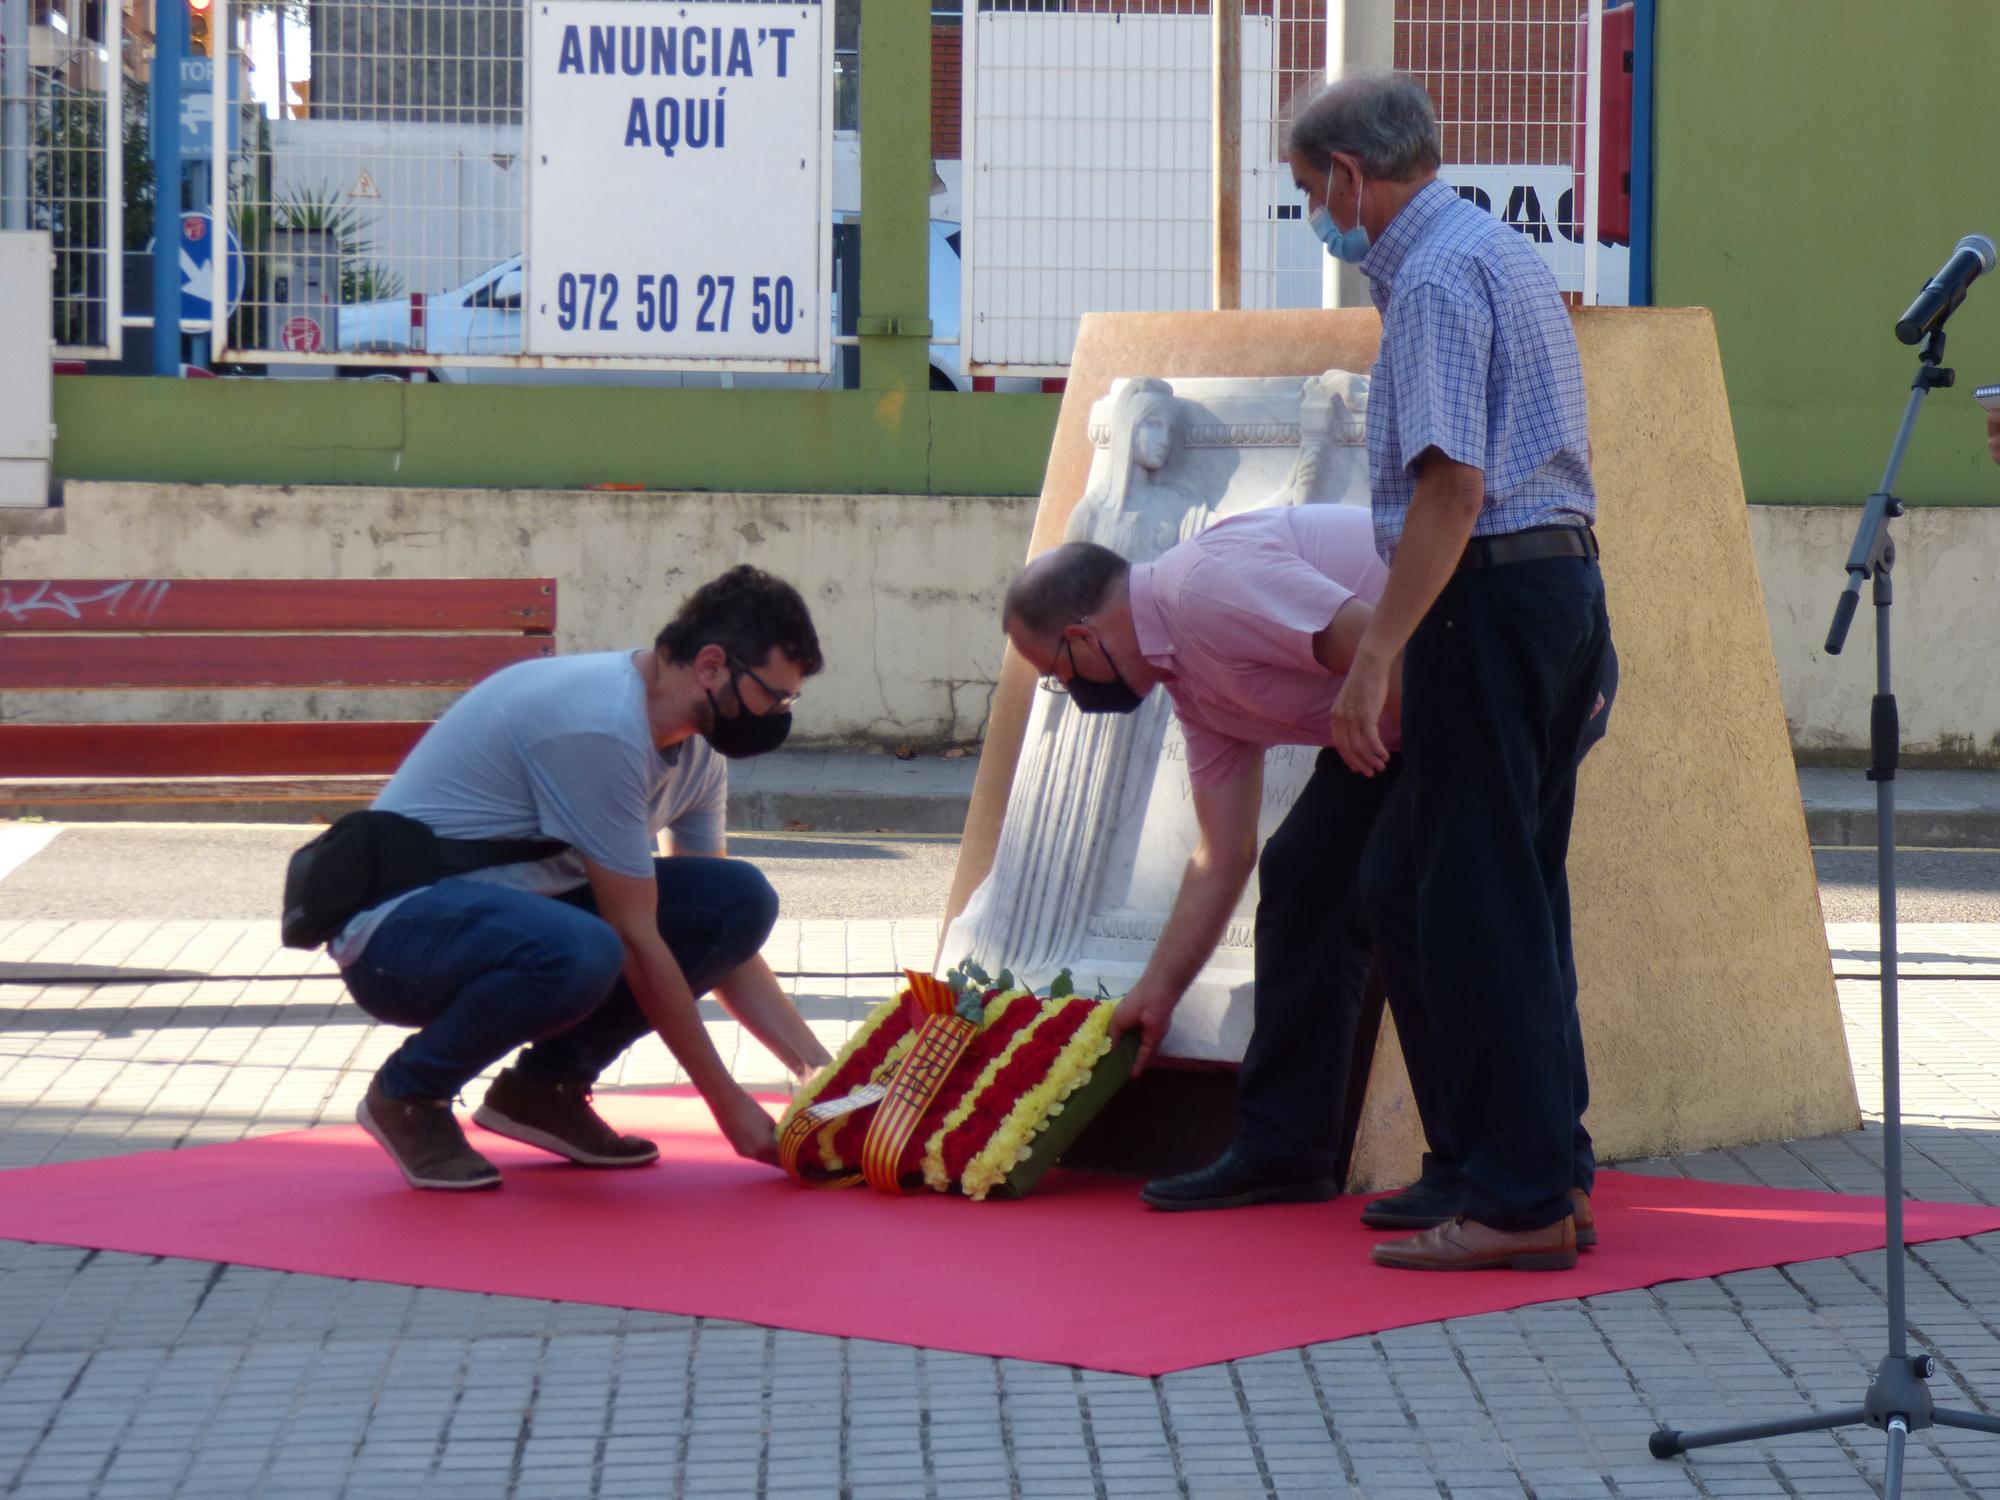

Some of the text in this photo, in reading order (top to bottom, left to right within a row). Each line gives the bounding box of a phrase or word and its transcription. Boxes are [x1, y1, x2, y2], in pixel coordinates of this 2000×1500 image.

[558, 25, 796, 78] ANUNCIA'T
[624, 86, 727, 158] AQUÍ
[558, 272, 794, 335] 972 50 27 50
